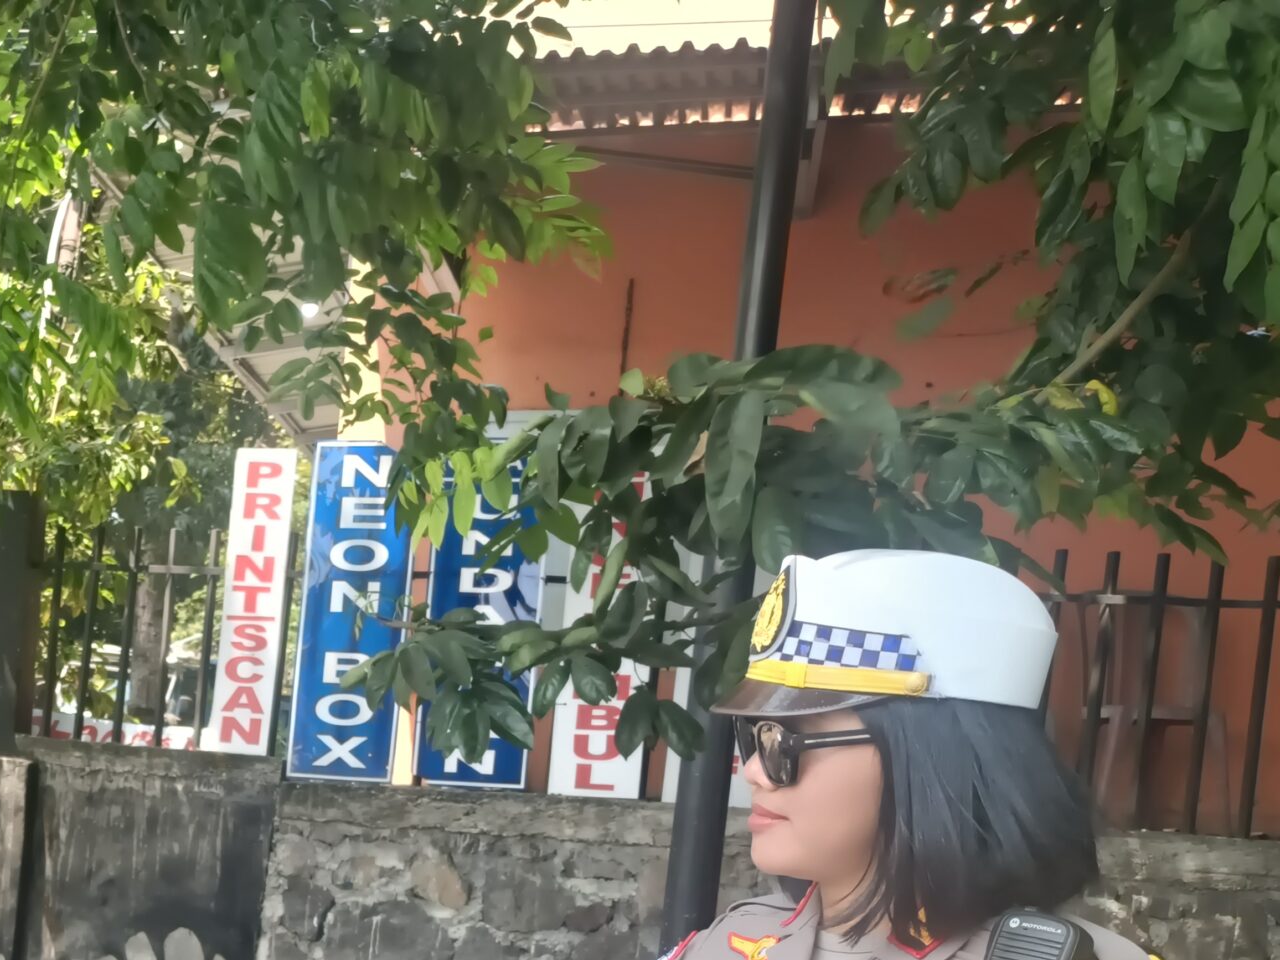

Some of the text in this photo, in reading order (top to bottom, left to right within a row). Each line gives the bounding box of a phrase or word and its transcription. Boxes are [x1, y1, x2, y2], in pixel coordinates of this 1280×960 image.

[219, 461, 283, 746] PRINT SCAN
[311, 454, 393, 769] NEON BOX
[1021, 922, 1062, 934] MOTOROLA
